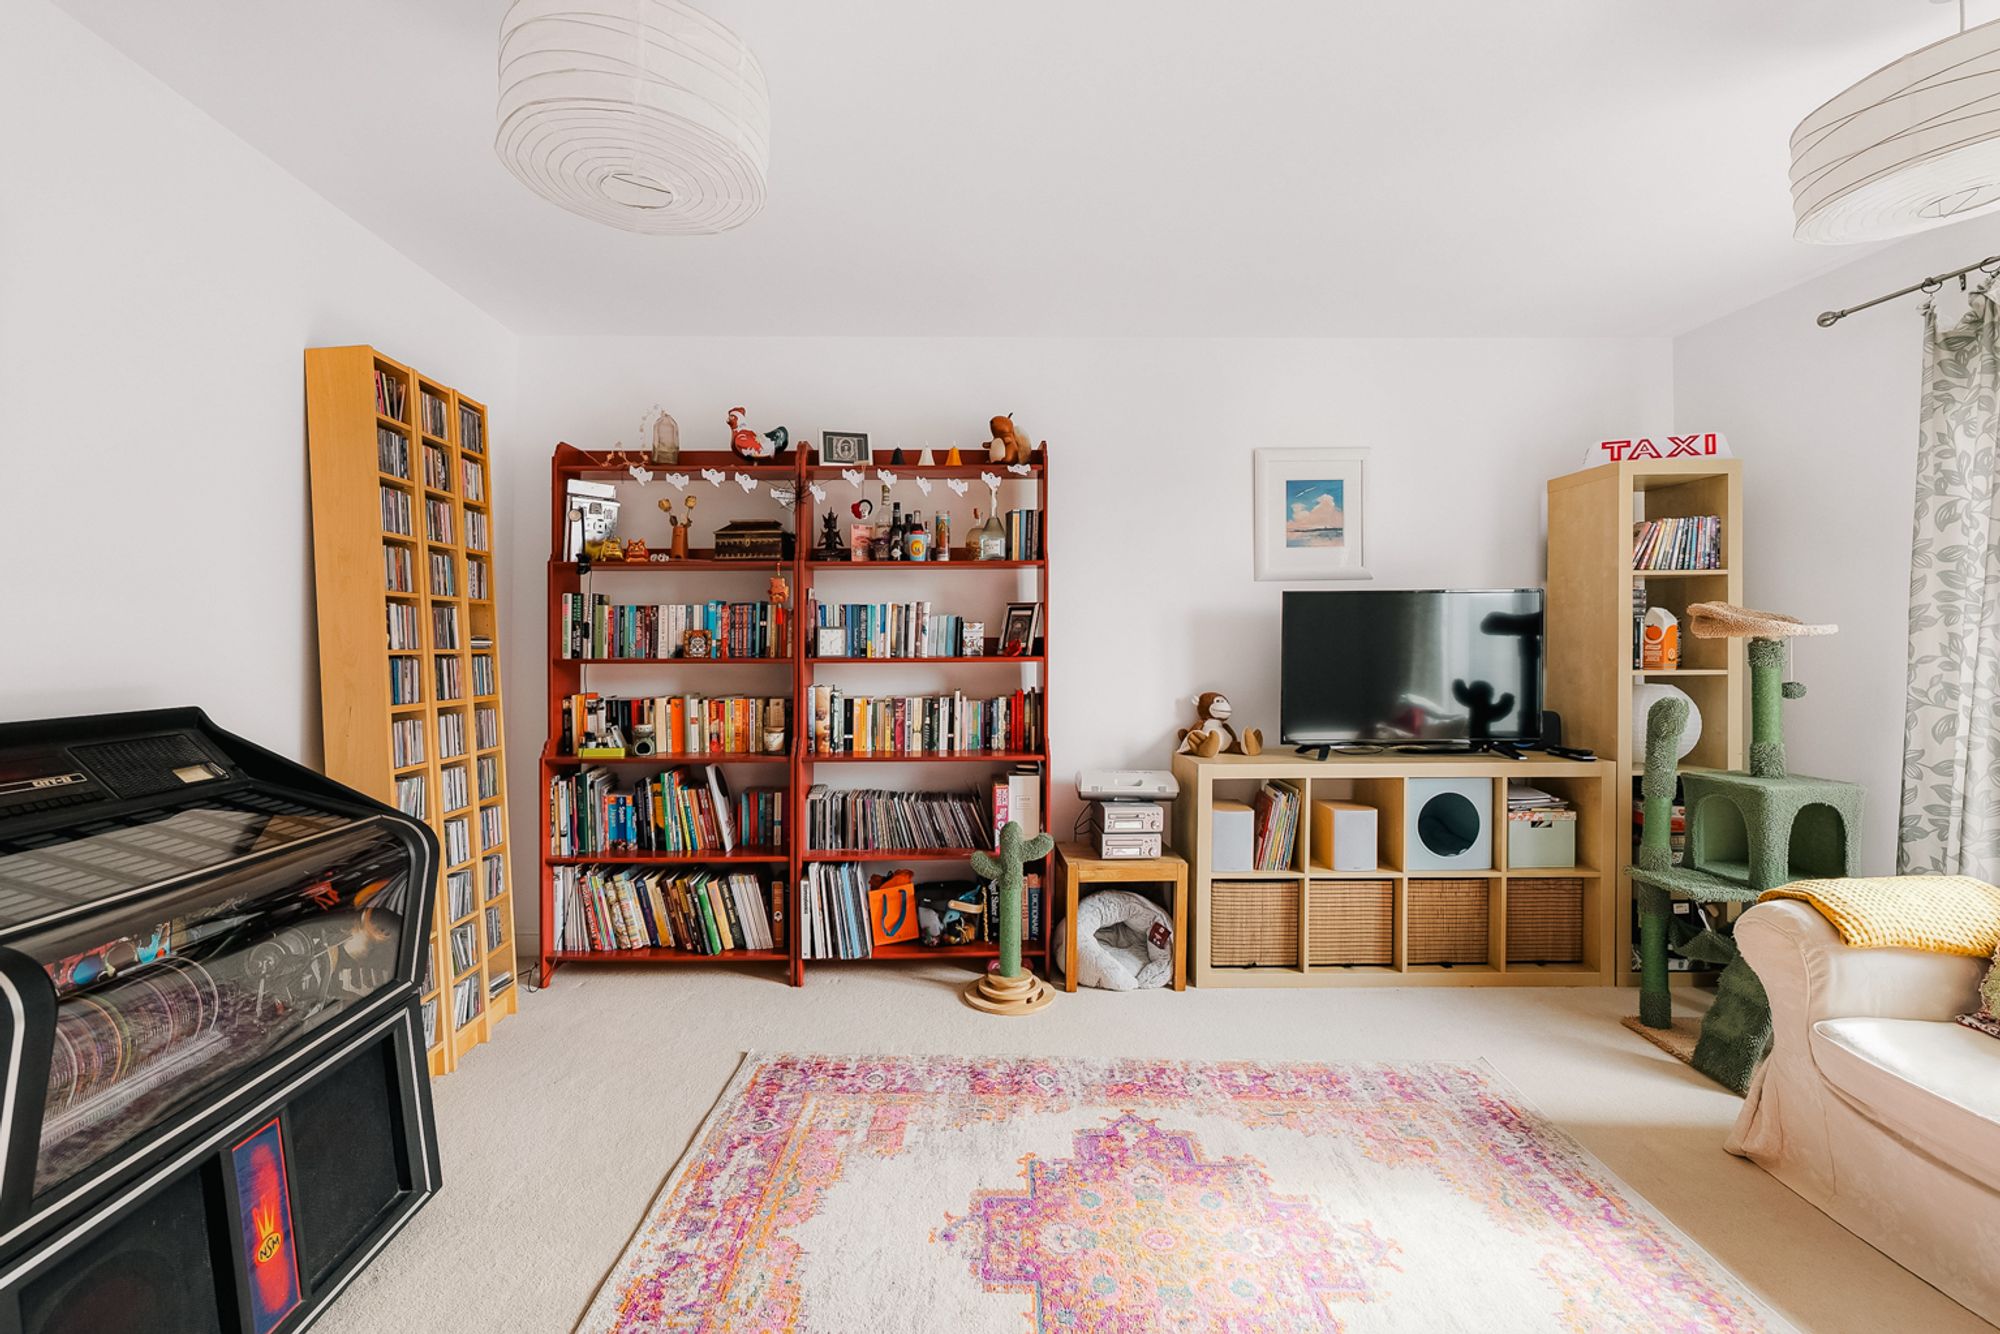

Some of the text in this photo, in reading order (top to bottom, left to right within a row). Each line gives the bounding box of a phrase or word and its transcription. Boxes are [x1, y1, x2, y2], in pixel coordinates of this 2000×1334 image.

[1601, 433, 1717, 462] TAXI
[991, 896, 999, 916] Slater
[1031, 893, 1040, 936] DICTIONARY
[259, 1235, 281, 1259] NSM
